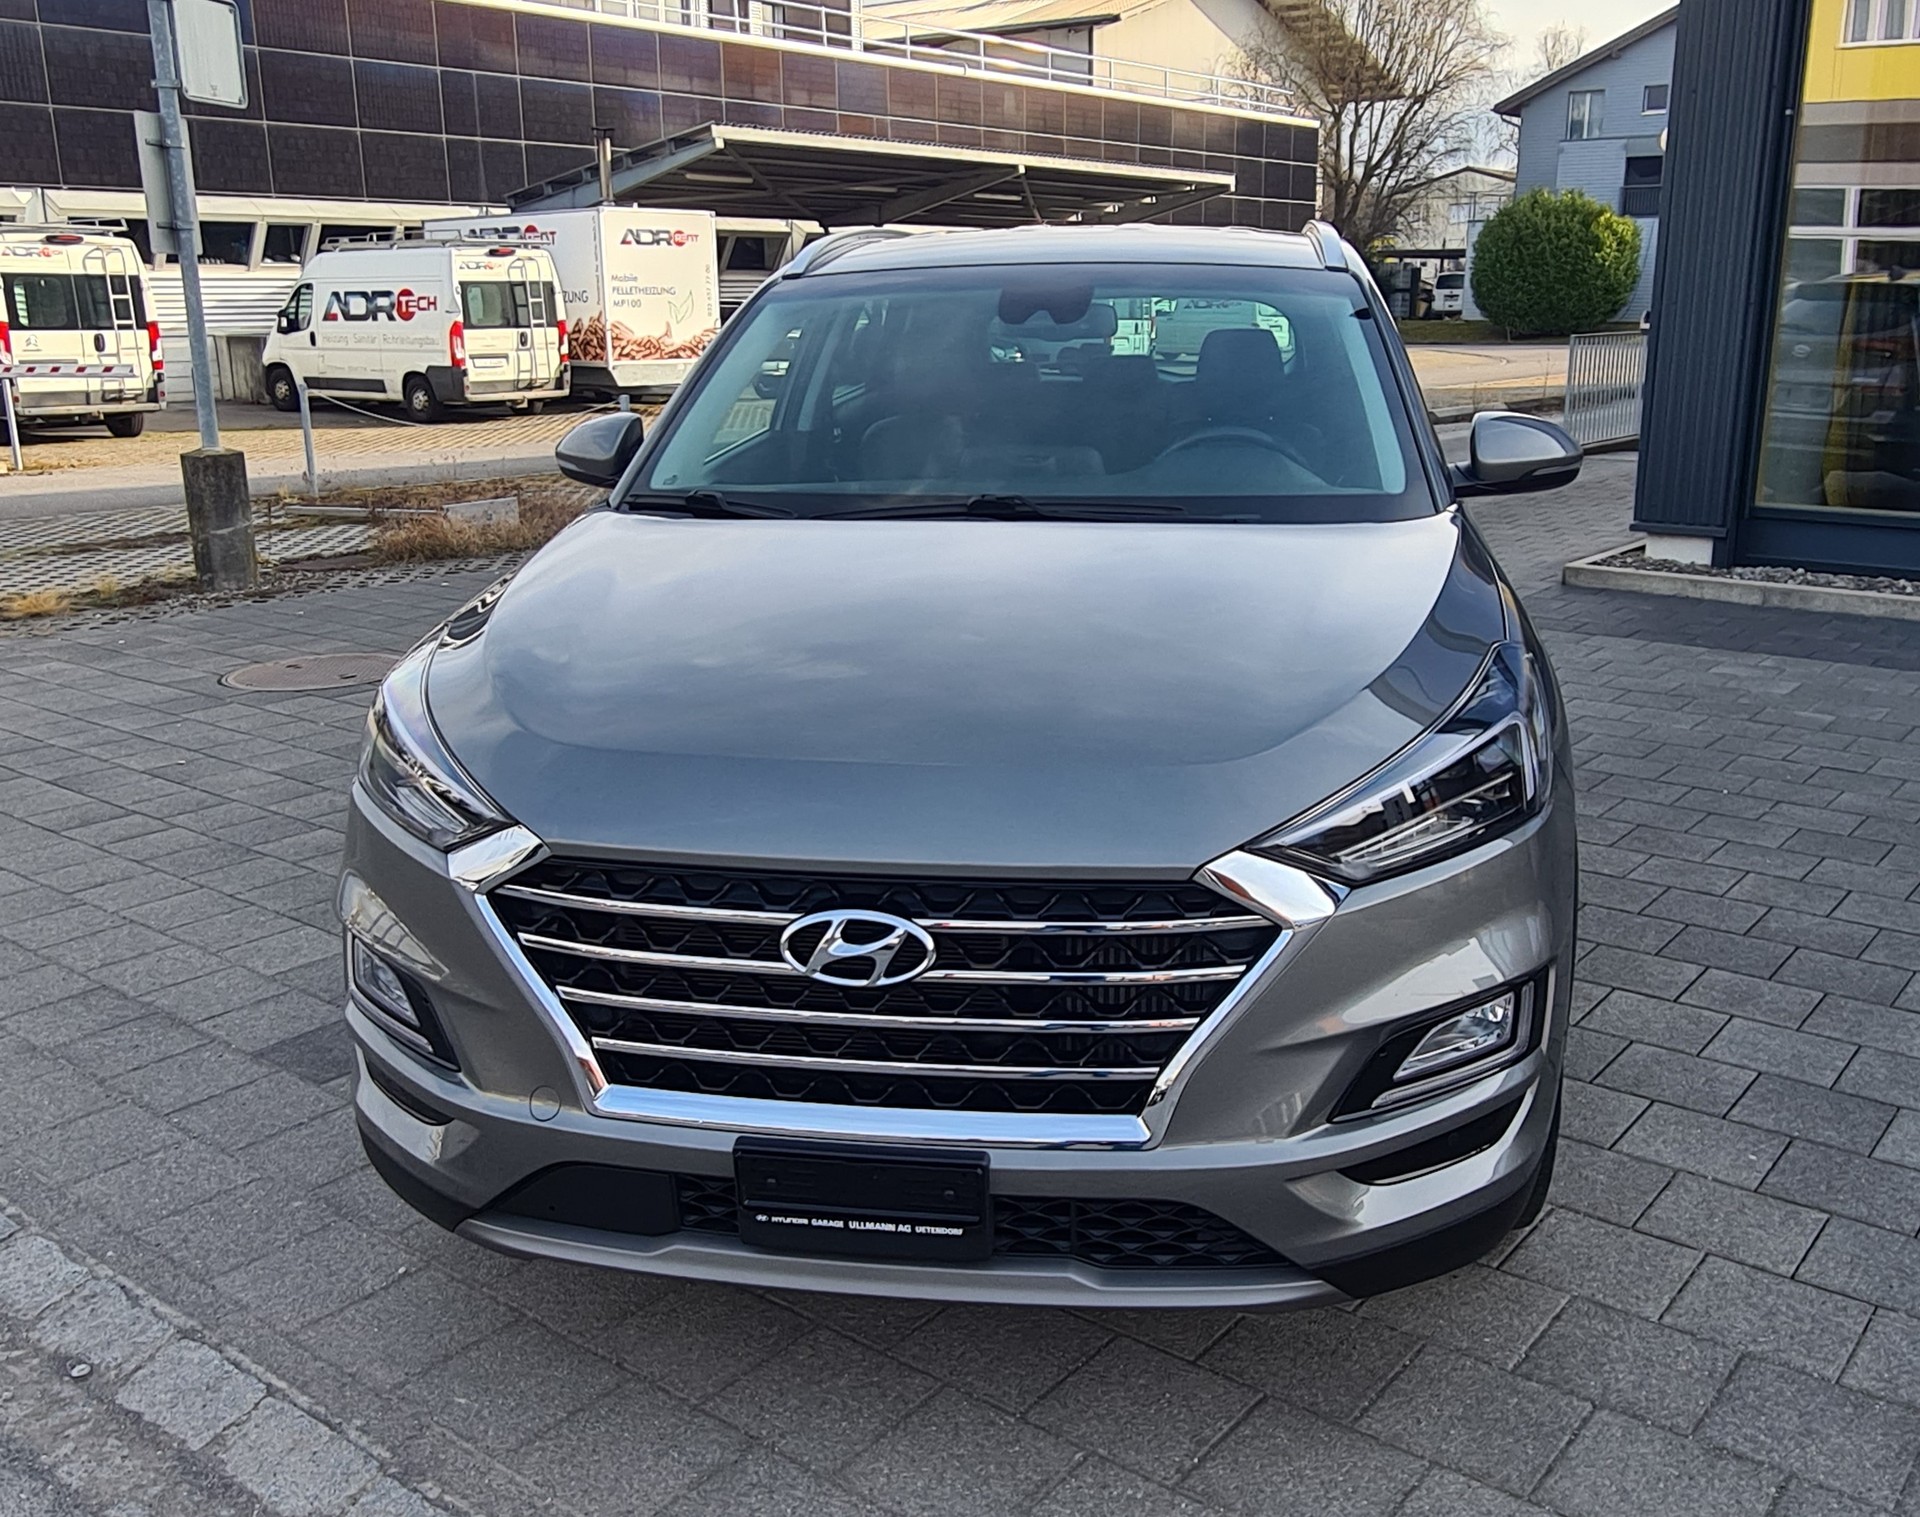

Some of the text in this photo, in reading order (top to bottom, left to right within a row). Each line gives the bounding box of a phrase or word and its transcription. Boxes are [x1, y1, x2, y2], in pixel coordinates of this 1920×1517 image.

[612, 286, 676, 295] PELLETHEIZUNG
[811, 1218, 844, 1228] GARAGE
[848, 1220, 896, 1232] ULLMANN
[897, 1224, 911, 1233] AG
[915, 1226, 963, 1236] UETENDORF
